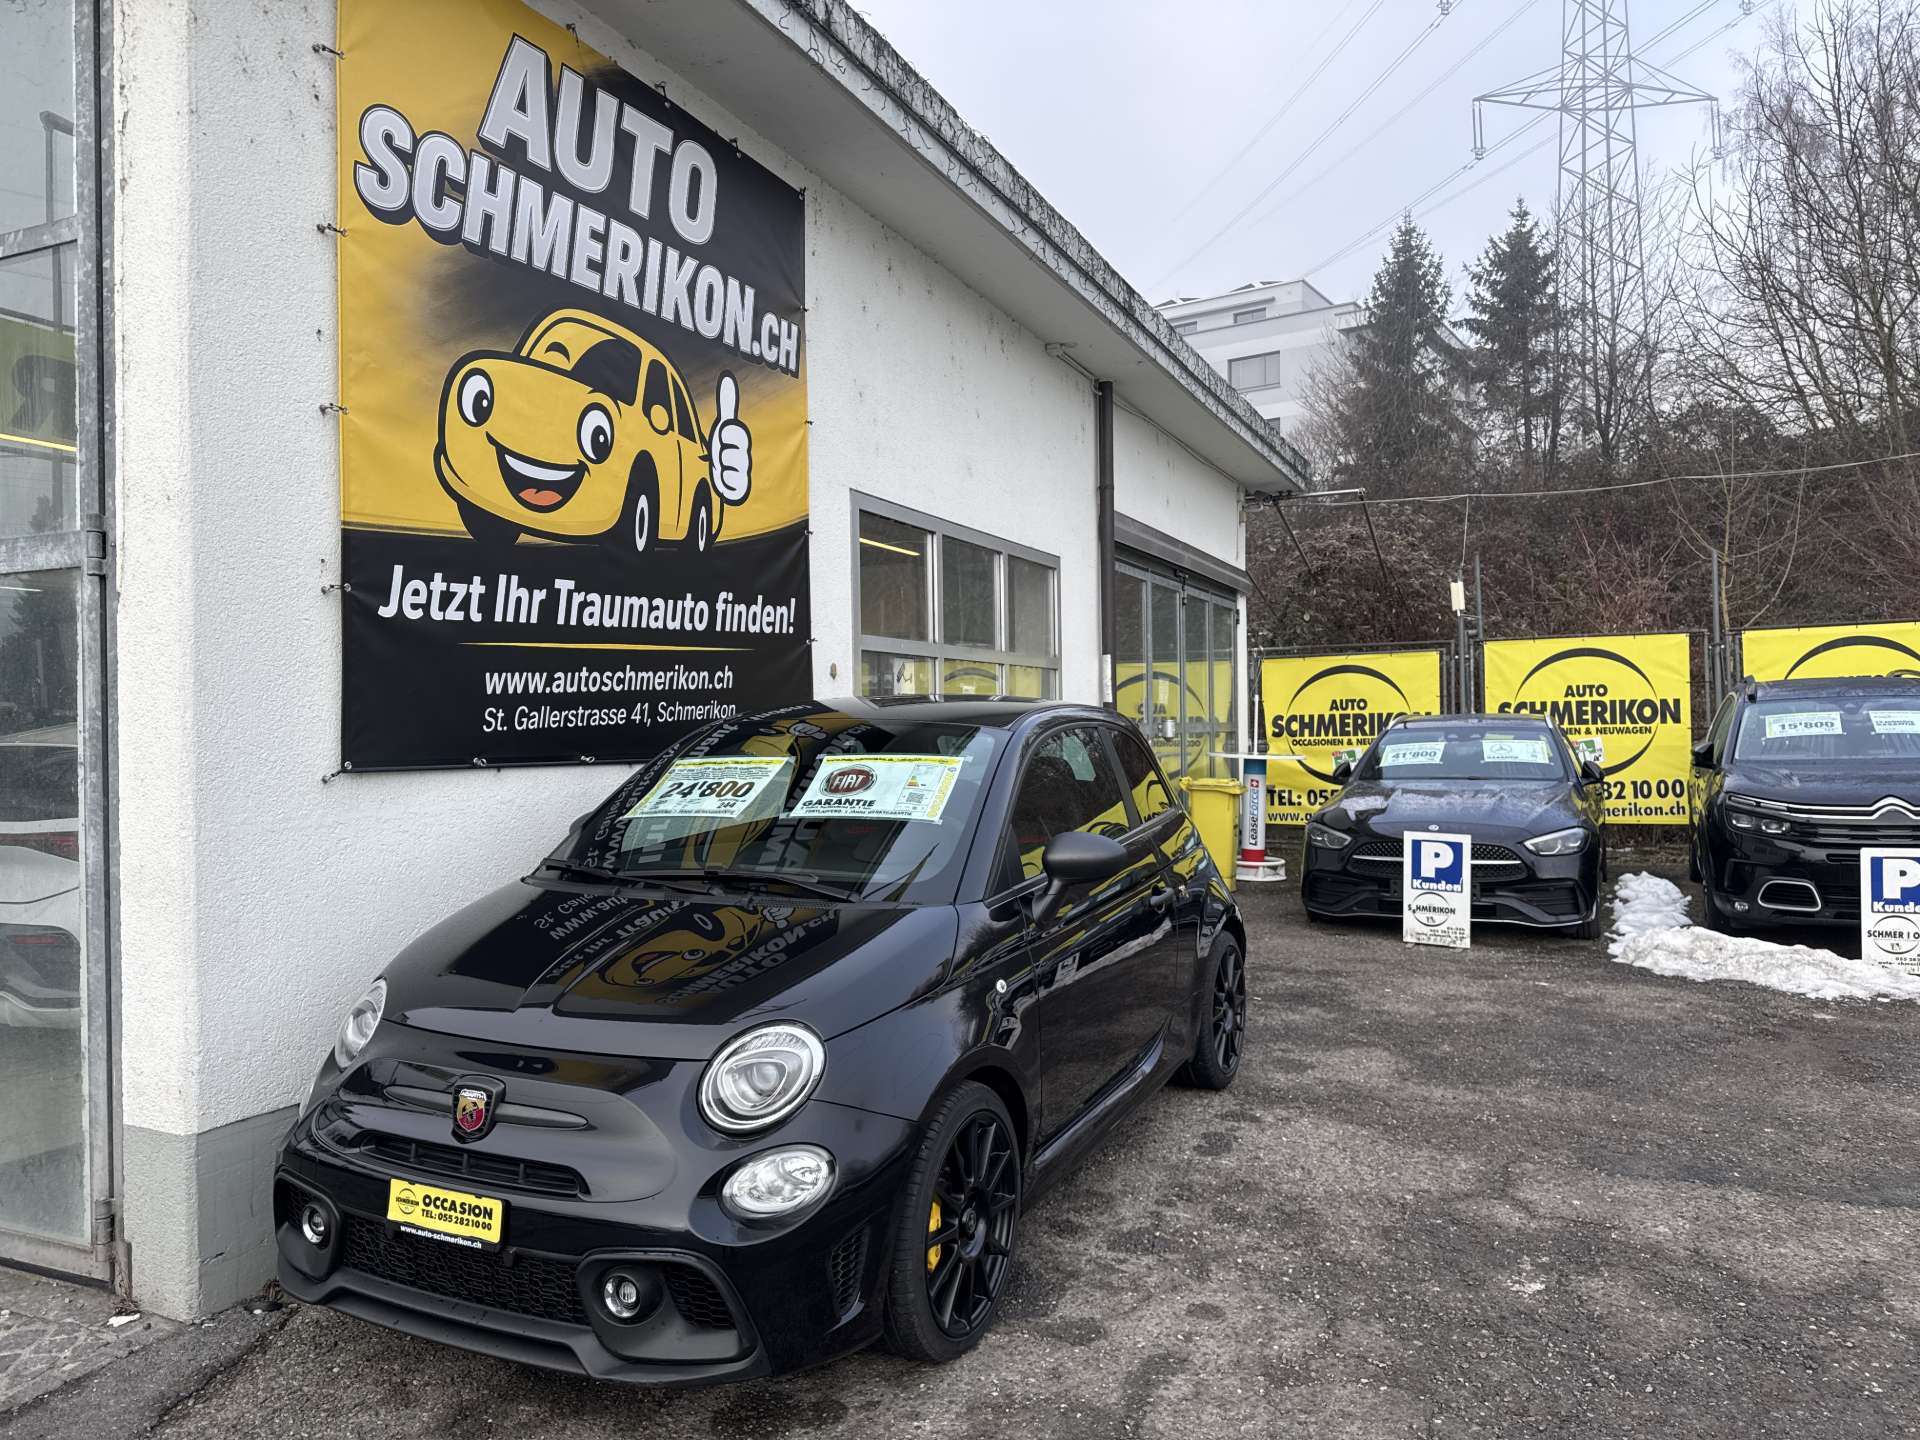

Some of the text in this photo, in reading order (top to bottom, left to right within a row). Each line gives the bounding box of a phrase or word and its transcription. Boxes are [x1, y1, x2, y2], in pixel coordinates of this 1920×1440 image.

[478, 32, 718, 245] AUTO
[353, 104, 800, 376] SCHMERIKON.CH
[376, 564, 796, 635] Jetzt Ihr Traumauto finden!
[484, 664, 734, 695] www.autoschmerikon.ch
[1564, 683, 1608, 699] AUTO
[1329, 698, 1368, 711] AUTO
[482, 700, 737, 732] St. Gallerstrasse 41, Schmerikon
[1777, 720, 1835, 731] 15'800
[1584, 726, 1593, 735] &
[1595, 725, 1652, 736] NEUWAGEN
[1291, 737, 1344, 747] OCCASIONEN
[1346, 738, 1354, 746] &
[1391, 749, 1438, 760] 41'800
[658, 780, 756, 800] 24'800
[831, 773, 867, 791] FIAT
[1630, 779, 1651, 799] 10
[1656, 778, 1686, 798] 00
[802, 798, 877, 808] GARANTIE
[1267, 788, 1302, 807] TEL:
[1248, 788, 1260, 847] LeaseForce
[1420, 840, 1454, 878] P
[1412, 878, 1462, 892] Kunden
[1882, 858, 1920, 900] P
[422, 1194, 493, 1220] OCCASION
[421, 1208, 492, 1231] TEL: 055 282 10 00
[400, 1225, 482, 1249] www.auto-schmerikon.ch
